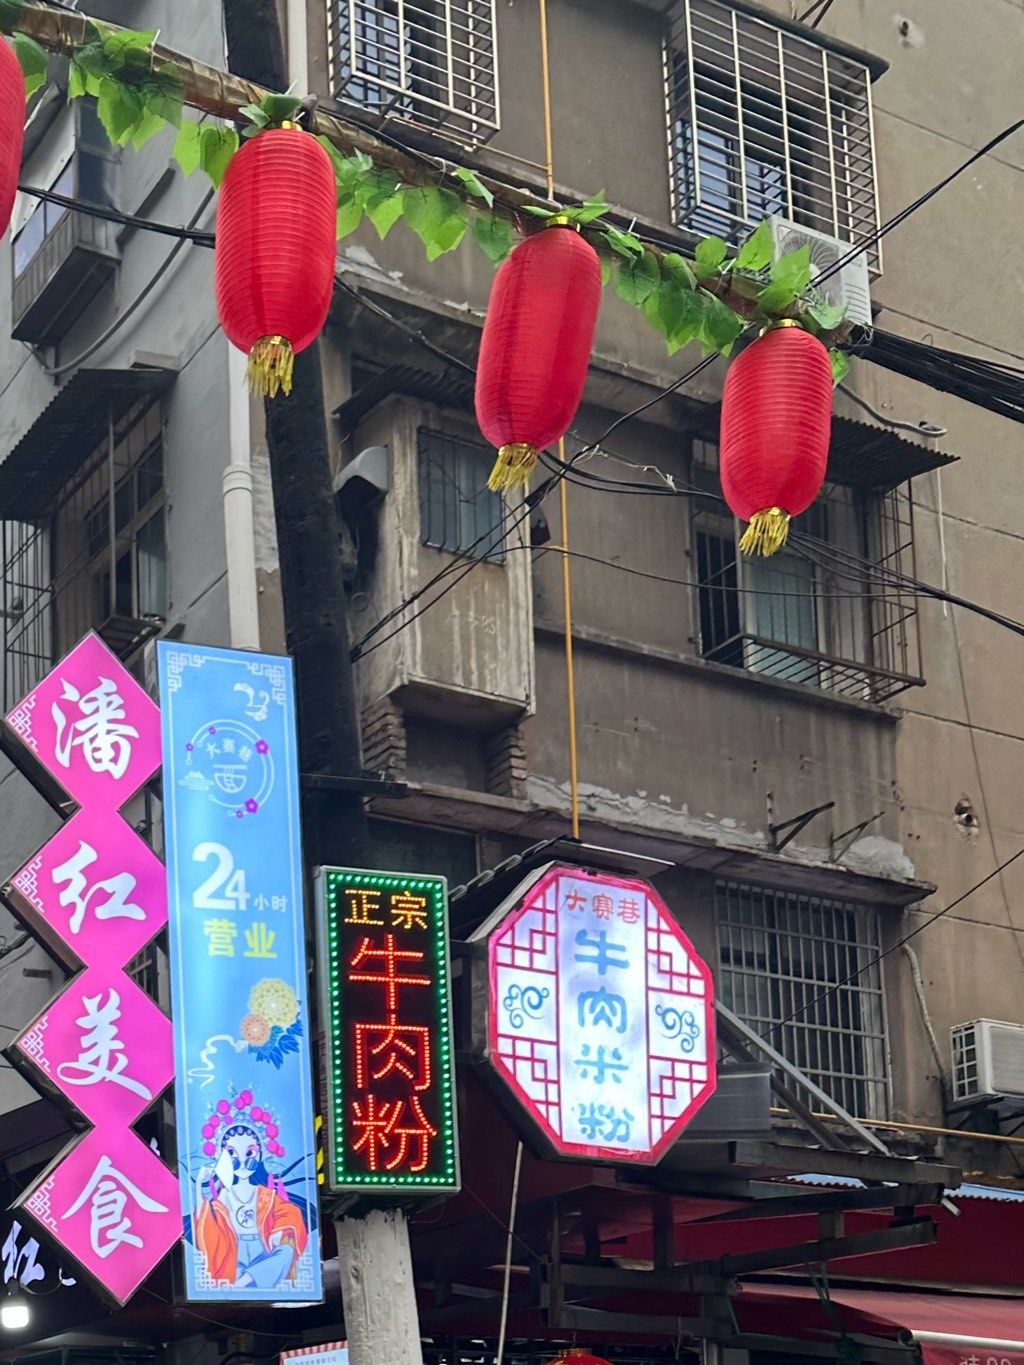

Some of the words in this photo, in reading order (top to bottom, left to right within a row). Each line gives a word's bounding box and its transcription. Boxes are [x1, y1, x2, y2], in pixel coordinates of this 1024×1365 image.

[205, 737, 253, 762] 大赛巷
[192, 841, 288, 913] 24小时
[343, 888, 429, 930] 正宗
[564, 888, 641, 925] 大赛巷
[202, 917, 279, 959] 营业
[51, 675, 169, 1259] 潘红美食
[347, 932, 438, 1173] 牛肉粉
[574, 928, 636, 1144] 牛肉米粉
